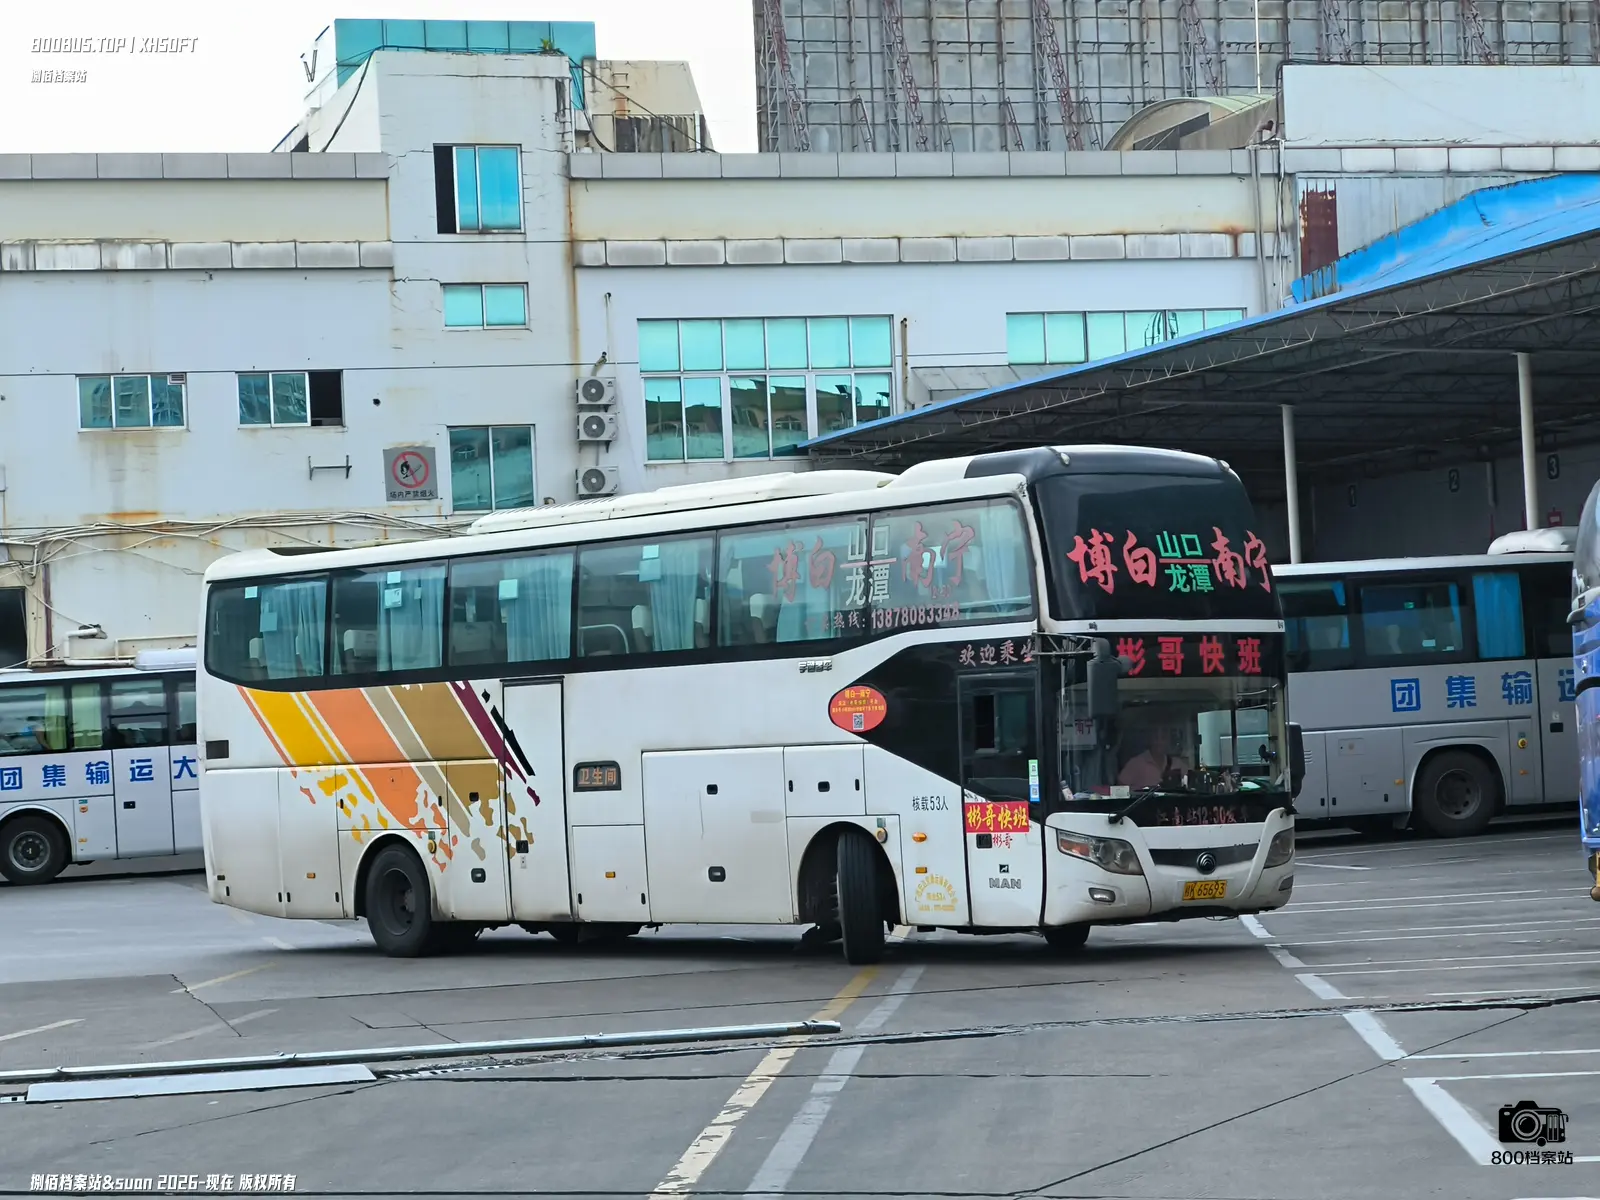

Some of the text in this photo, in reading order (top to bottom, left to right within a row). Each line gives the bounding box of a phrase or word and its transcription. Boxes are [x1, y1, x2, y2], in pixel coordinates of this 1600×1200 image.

[1550, 457, 1557, 476] 3
[1450, 470, 1458, 490] 2
[1067, 526, 1271, 595] 博白 山口 南宁
[845, 564, 891, 606] 龙潭
[1164, 564, 1215, 593] 龙潭
[578, 767, 617, 785] 卫生间
[912, 795, 949, 811] 核载53人
[967, 803, 1028, 832] 彬哥快班
[989, 877, 1022, 890] MAN
